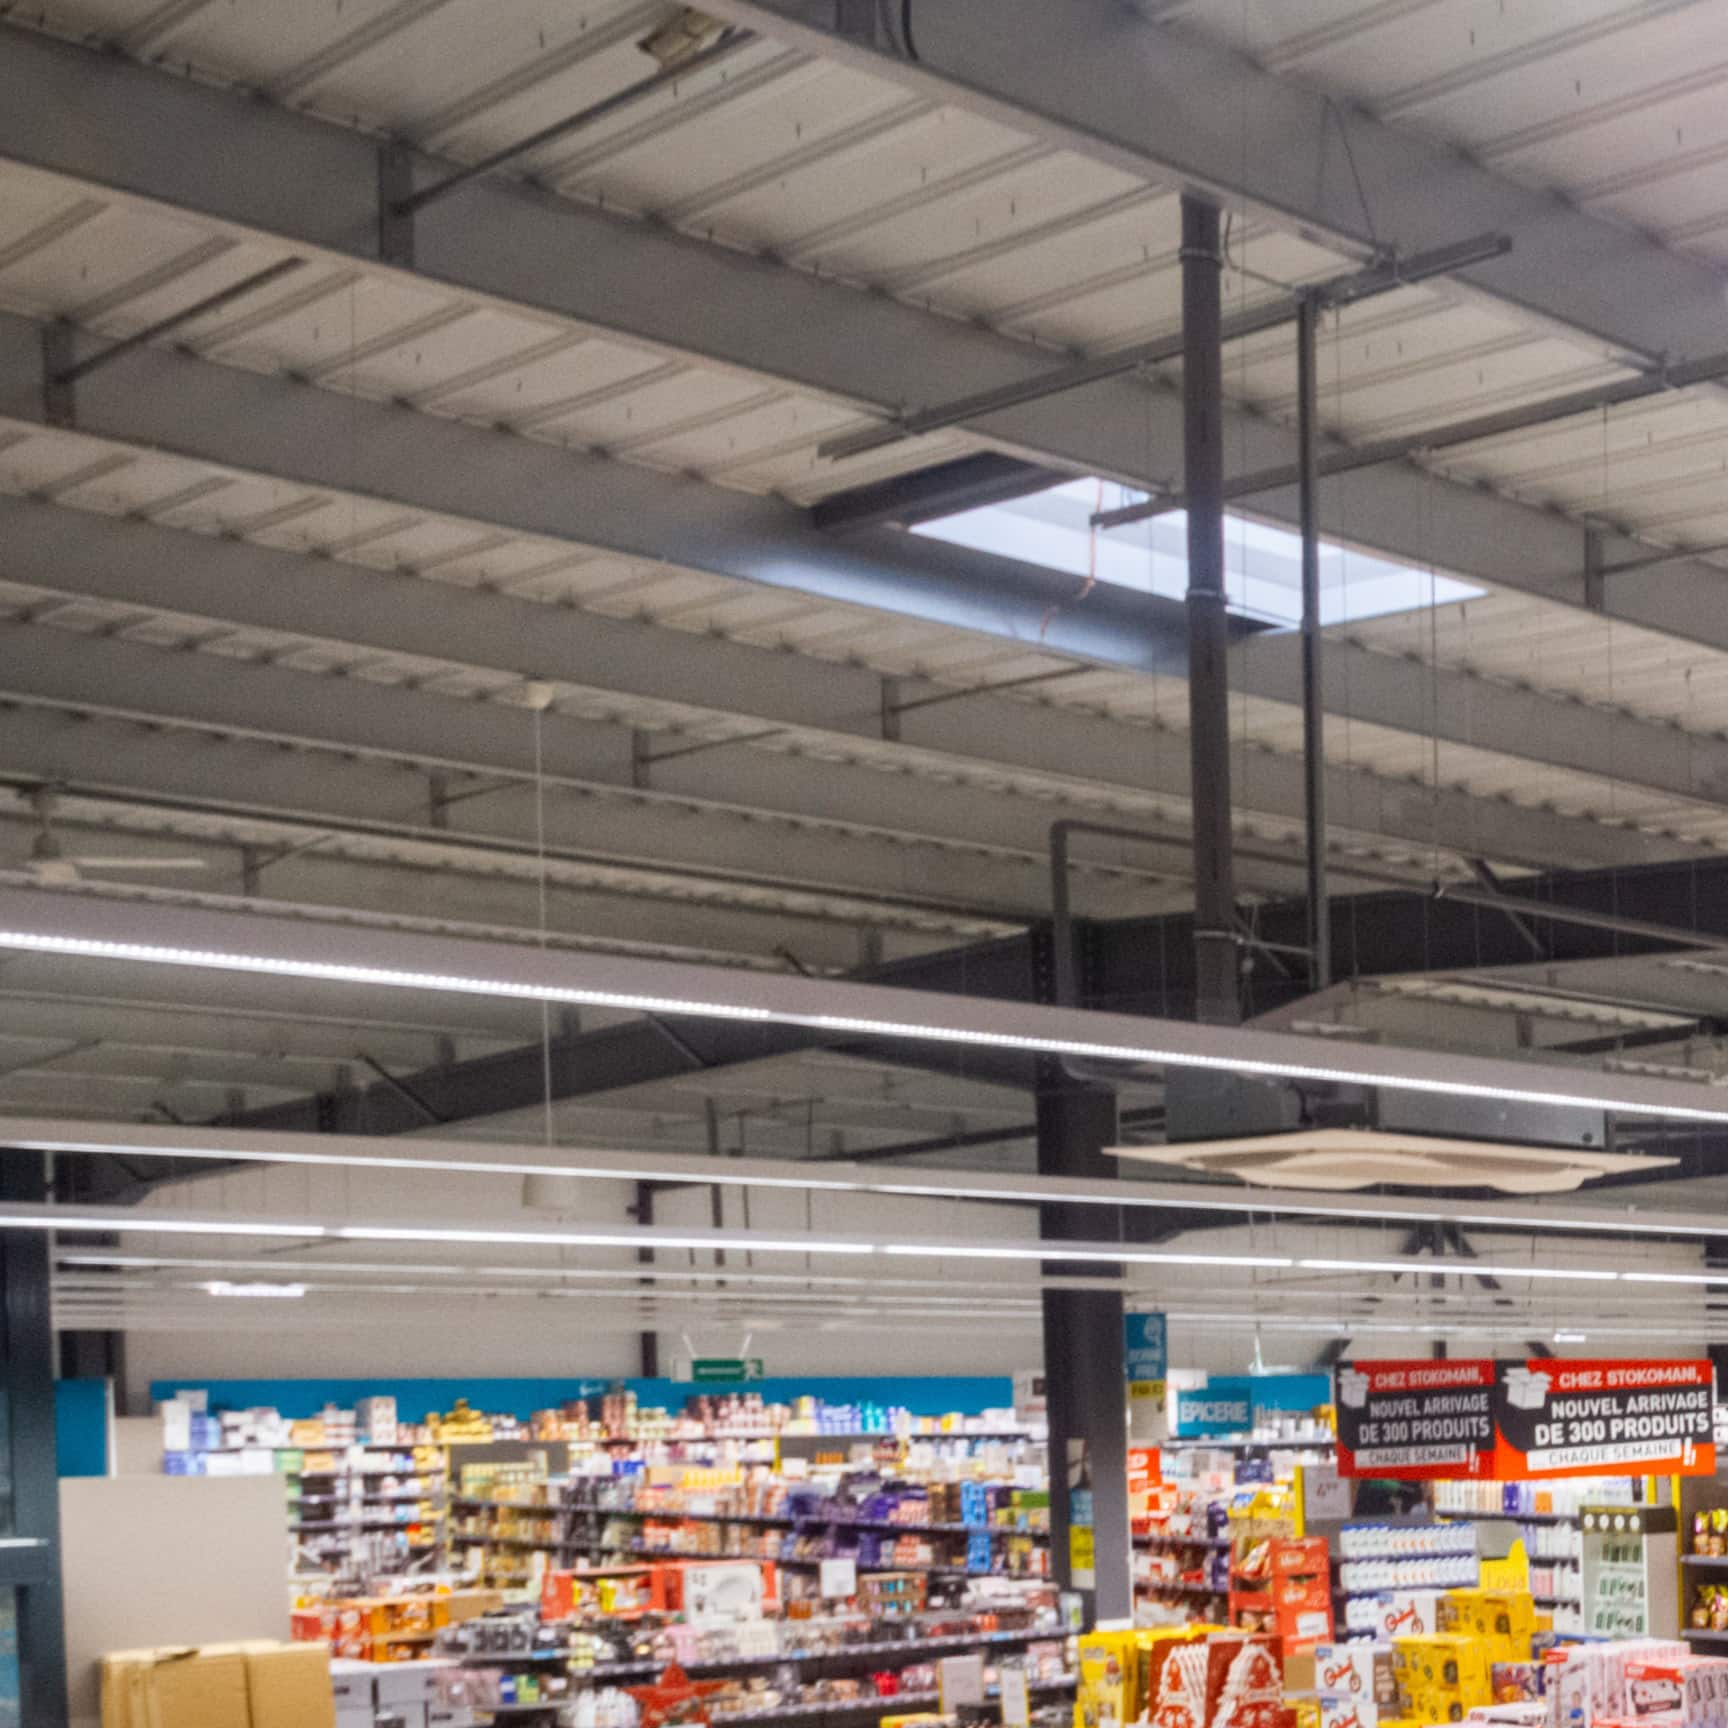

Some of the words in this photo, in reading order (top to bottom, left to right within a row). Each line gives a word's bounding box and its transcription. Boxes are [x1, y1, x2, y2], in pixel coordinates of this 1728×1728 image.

[1376, 1373, 1404, 1387] CHEZ
[1408, 1369, 1484, 1386] STOKOMANI,
[1559, 1370, 1603, 1388] CHEZ
[1606, 1366, 1702, 1386] STOKOMANI,
[1370, 1398, 1421, 1418] NOUVEL
[1423, 1393, 1489, 1413] ARRIVAGE
[1551, 1397, 1623, 1418] NOUVEL
[1626, 1391, 1708, 1413] ARRIVAGE
[1359, 1424, 1380, 1445] DE
[1382, 1422, 1410, 1443] 300
[1412, 1418, 1490, 1441] PRODUITS
[1535, 1424, 1565, 1446] DE
[1569, 1421, 1609, 1443] 300
[1613, 1411, 1710, 1440] PRODUITS
[1368, 1450, 1408, 1466] CHAQUE
[1411, 1447, 1463, 1464] SEMAINE
[1548, 1448, 1609, 1466] CHAQUE
[1613, 1442, 1677, 1461] SEMAINE
